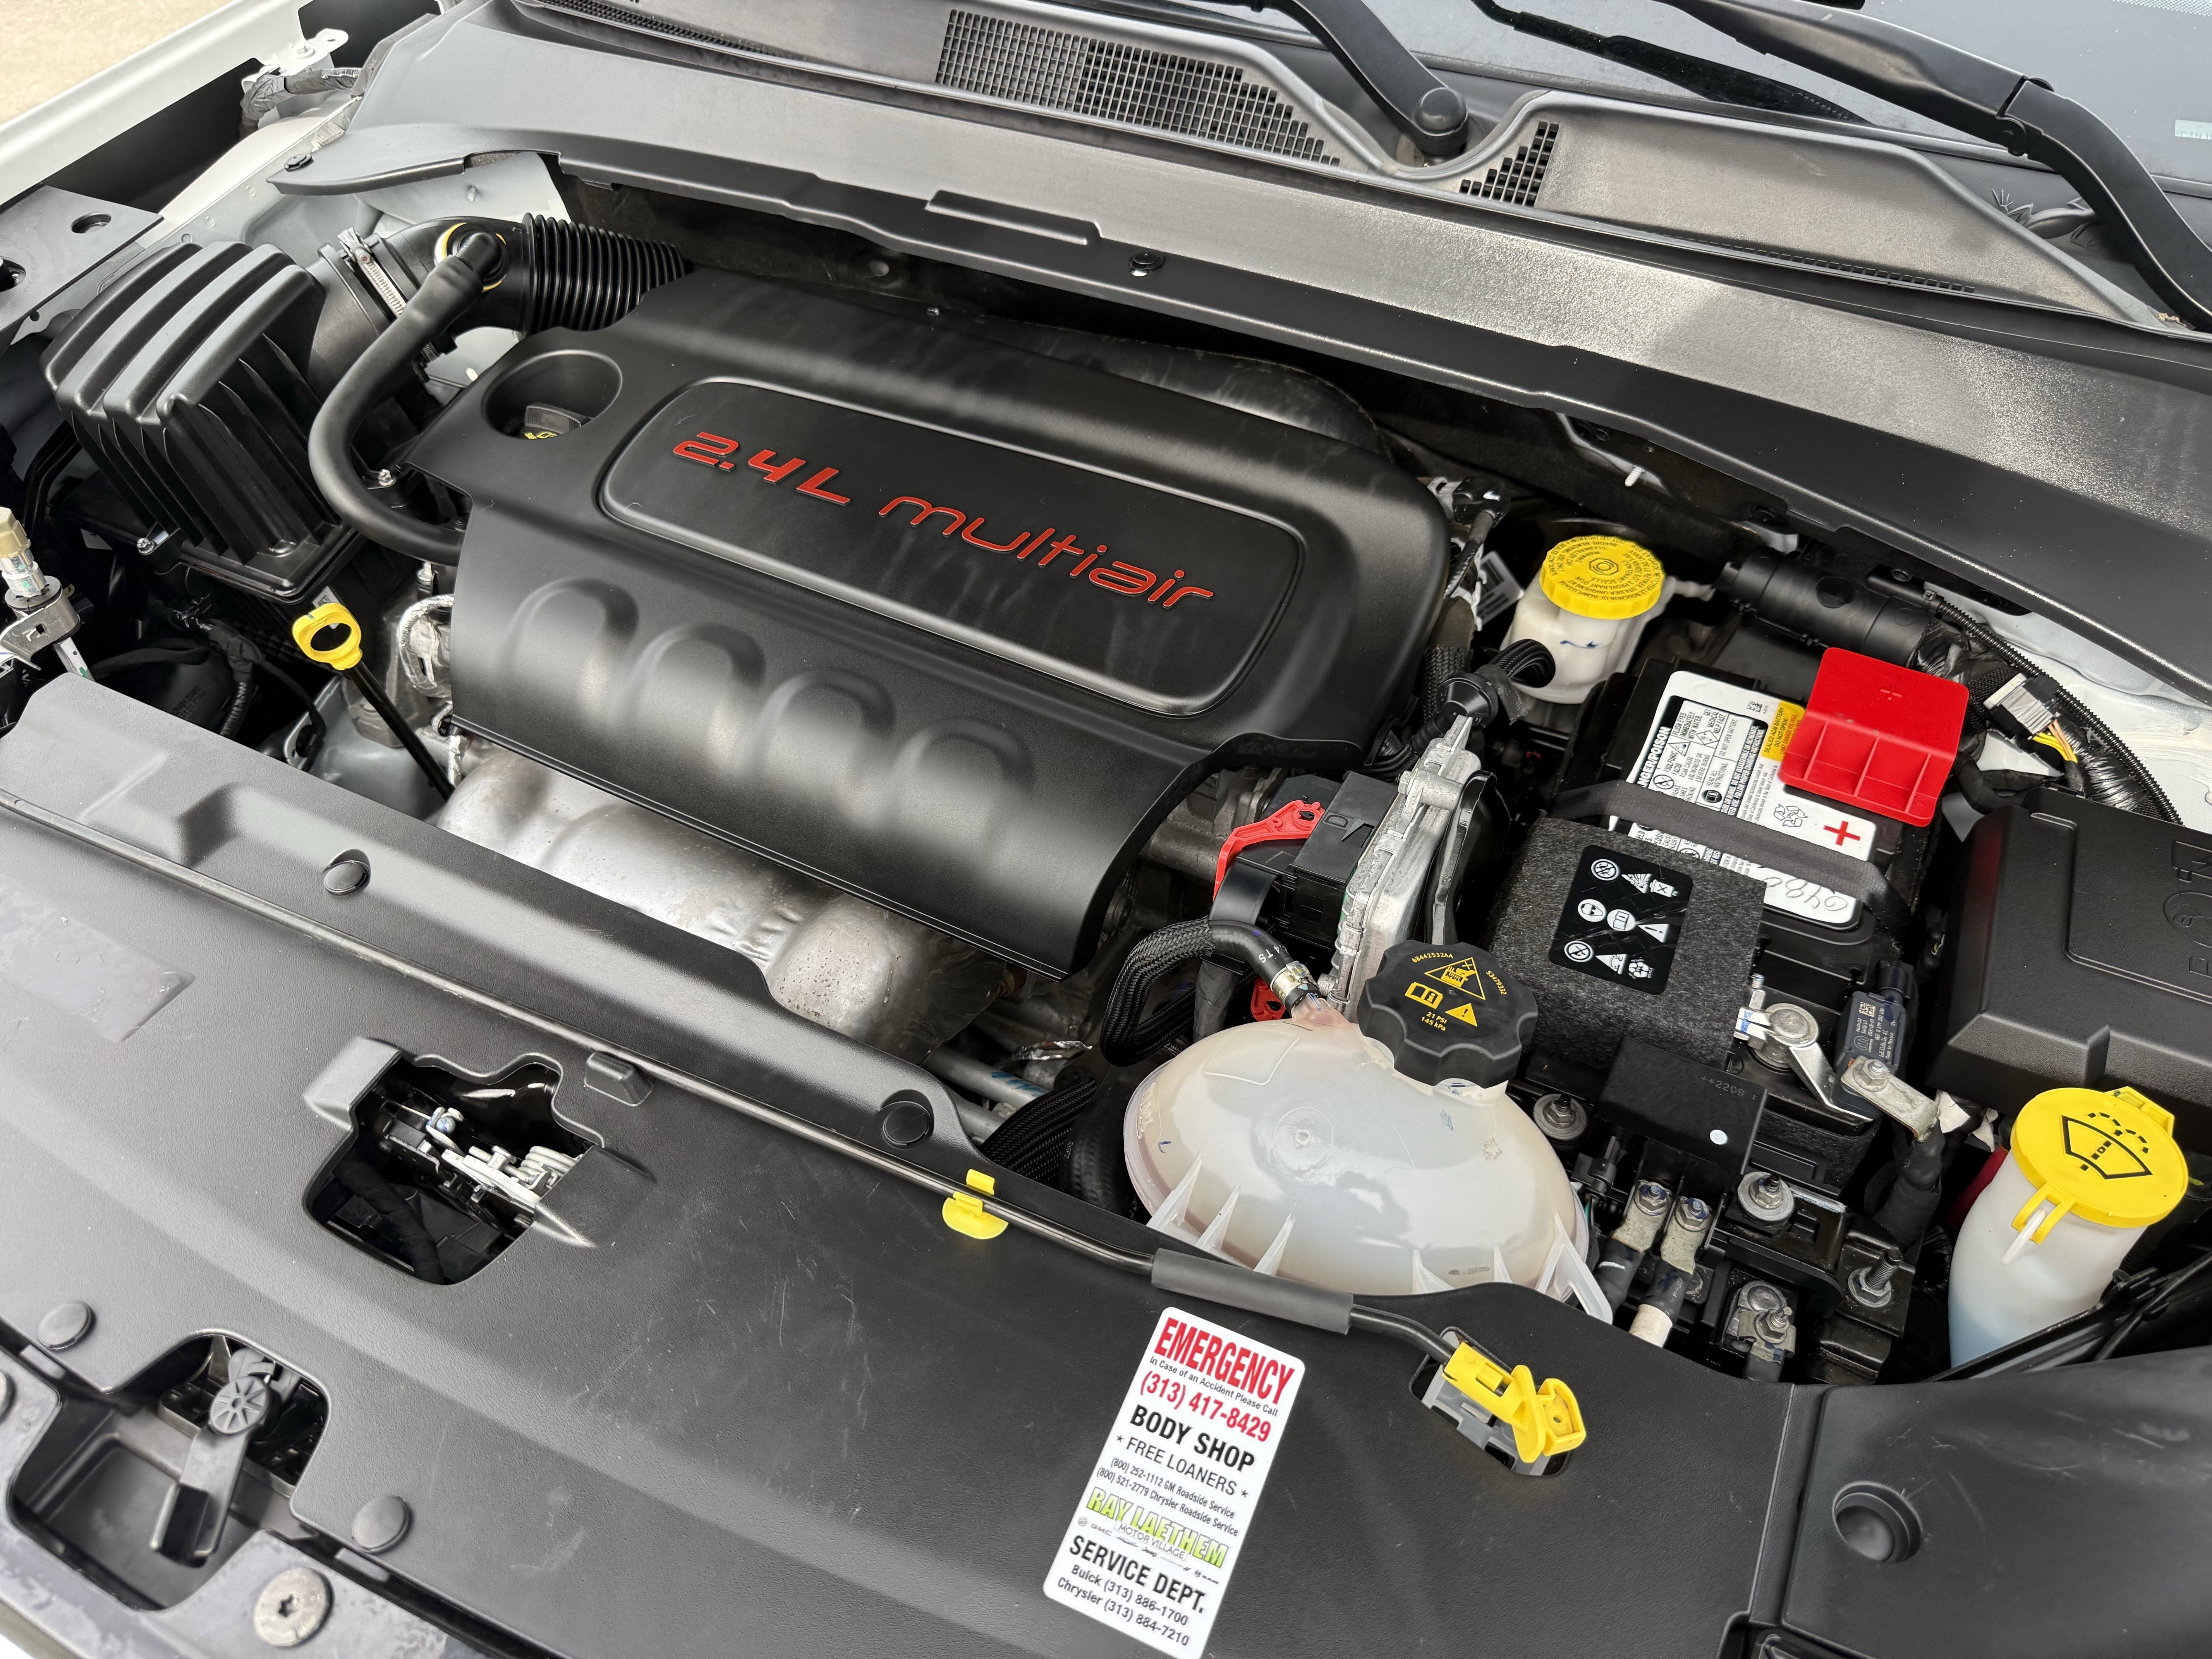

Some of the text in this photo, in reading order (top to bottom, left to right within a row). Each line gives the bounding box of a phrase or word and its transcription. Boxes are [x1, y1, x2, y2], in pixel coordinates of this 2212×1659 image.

[673, 431, 1214, 607] 2.4L multiair
[1672, 713, 1686, 736] FLUSH EYES
[1680, 712, 1695, 738] IMMEDIATELY
[1707, 712, 1719, 728] MEDICAL
[1712, 724, 1721, 735] HELP
[1764, 736, 1774, 753] SEALED
[1774, 707, 1784, 726] BATTERY
[1782, 730, 1791, 744] CHARGE
[1788, 714, 1797, 729] VOLTAGE
[1687, 729, 1696, 740] WITH
[1723, 734, 1732, 743] OPEN
[1637, 726, 1671, 788] NGER/POISON
[1664, 751, 1678, 771] SULFURIC
[1673, 763, 1682, 773] ACID
[1684, 756, 1693, 768] CAUSE
[1688, 758, 1700, 778] BLINDNESS
[1696, 767, 1705, 780] SEVERE
[1706, 777, 1715, 787] READ
[1671, 785, 1680, 797] PARKS
[1685, 787, 1695, 802] MOKING
[1412, 952, 1453, 963] 68442532AA
[1486, 970, 1507, 995] 53479332
[1421, 1017, 1446, 1031] 145 kPa
[1436, 1016, 1448, 1024] PSI
[1154, 1317, 1295, 1404] EMERGENCY
[1150, 1356, 1158, 1365] In
[1159, 1360, 1177, 1373] Case
[1188, 1374, 1198, 1382] an
[1200, 1378, 1234, 1398] Accident
[1235, 1393, 1261, 1409] Please
[1263, 1404, 1278, 1417] Call
[1140, 1371, 1271, 1442] (313) 417-8429
[1130, 1405, 1254, 1471] BODY SHOP
[1126, 1437, 1237, 1495] FREE LOANERS
[1111, 1458, 1235, 1519] (800) 252-1112 GM Roadside Service
[1097, 1467, 1238, 1536] (800) 521-2779 Chrysler Roadside Service
[1086, 1487, 1229, 1568] RAY LAETHEM
[1118, 1523, 1149, 1543] MOTOR
[1152, 1537, 1185, 1559] VILLAGE
[1070, 1535, 1205, 1613] SERVICE DEPT.
[1071, 1565, 1188, 1626] Buick (313) 886-1700
[1058, 1577, 1189, 1646] Chrysler (313) 884-7210
